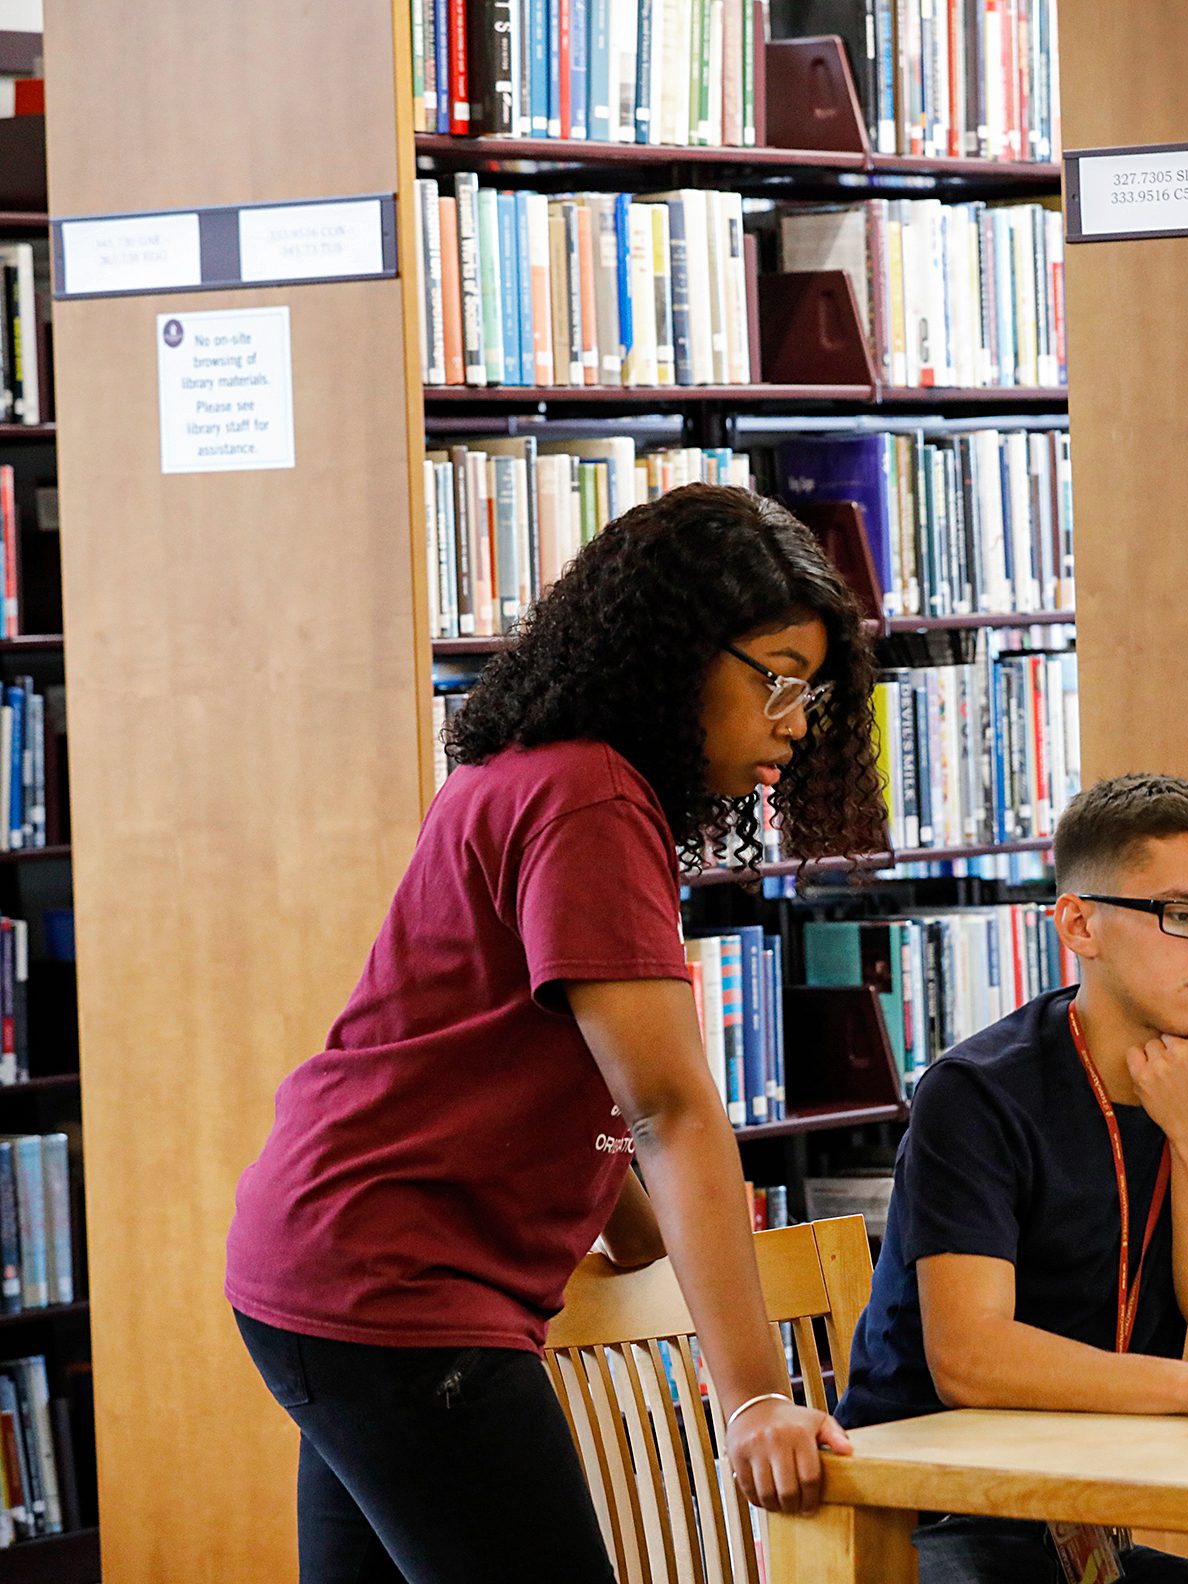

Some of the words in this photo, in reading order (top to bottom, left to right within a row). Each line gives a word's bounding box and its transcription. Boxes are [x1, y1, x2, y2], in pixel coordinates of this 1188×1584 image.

[1113, 170, 1173, 187] 327.7305
[1110, 188, 1171, 205] 333.9516
[194, 334, 210, 347] No
[213, 332, 252, 346] on-site
[193, 355, 243, 369] browsing
[246, 352, 257, 365] of
[181, 376, 214, 391] library
[218, 372, 269, 387] materials.
[196, 400, 232, 413] Please
[236, 400, 255, 411] see
[186, 421, 221, 437] library
[225, 419, 250, 433] staff
[254, 418, 269, 431] for
[197, 443, 257, 456] assistance.
[901, 683, 915, 752] DEVIL'S
[903, 754, 916, 802] MILK
